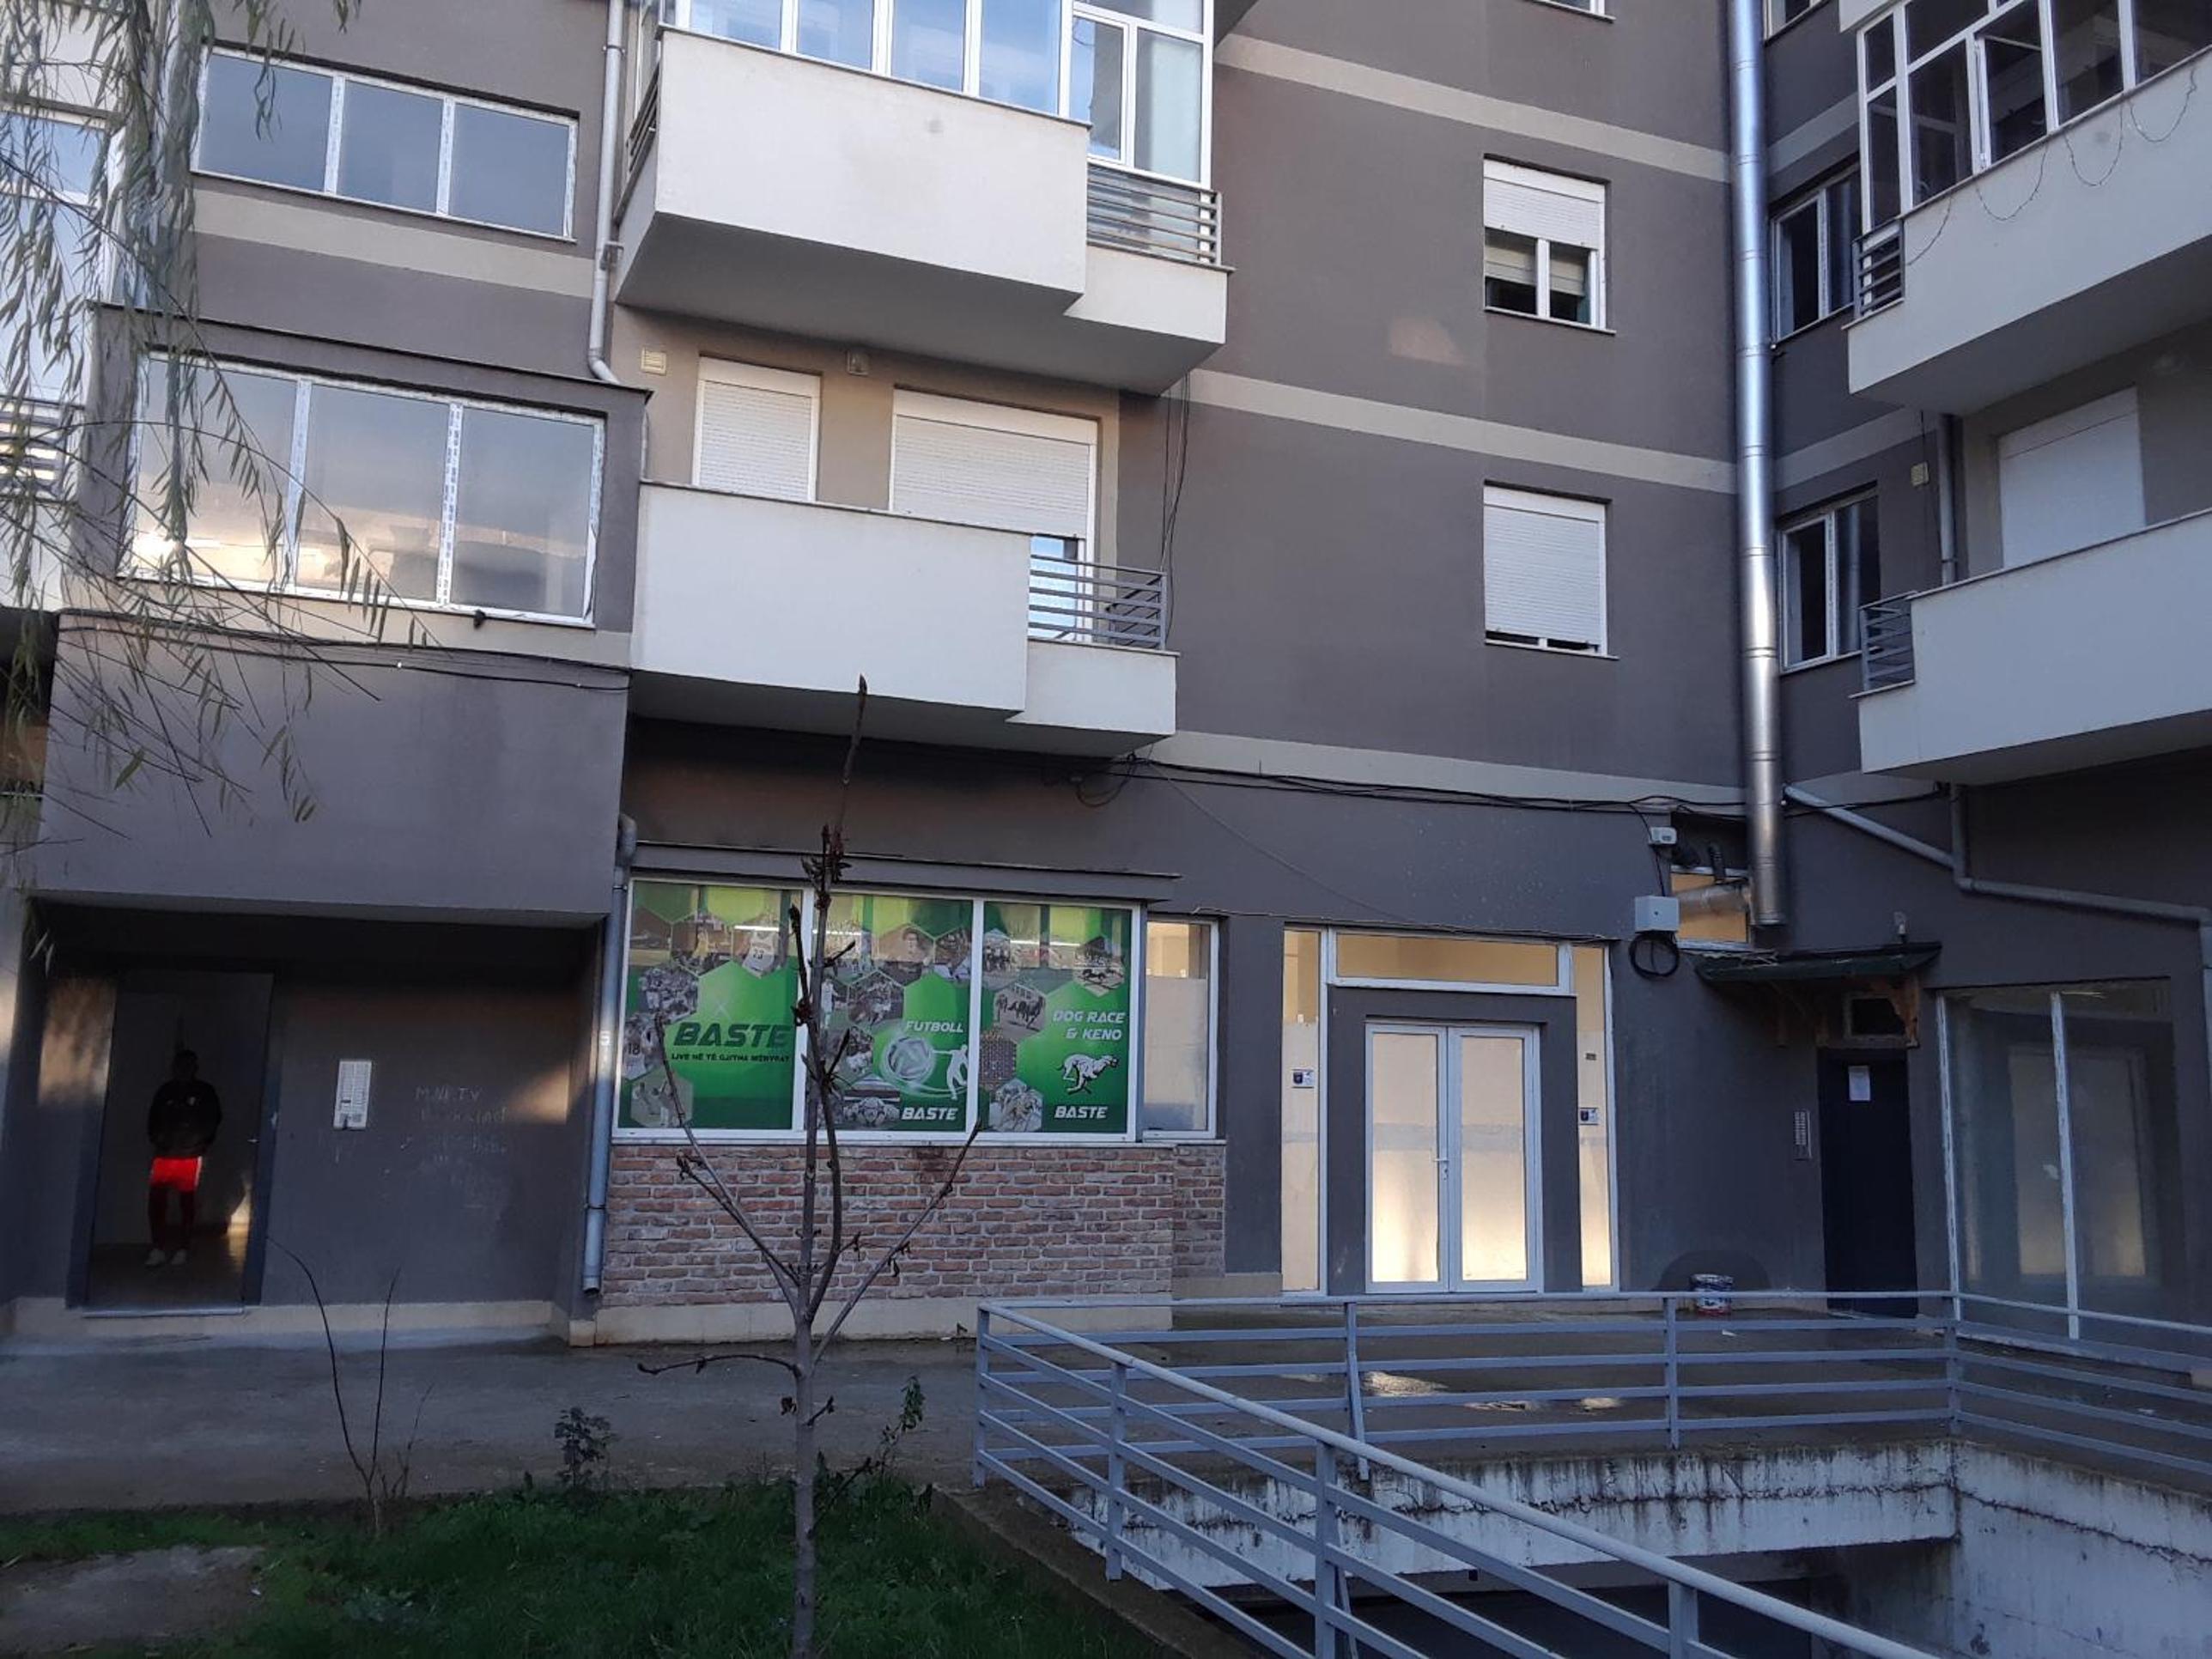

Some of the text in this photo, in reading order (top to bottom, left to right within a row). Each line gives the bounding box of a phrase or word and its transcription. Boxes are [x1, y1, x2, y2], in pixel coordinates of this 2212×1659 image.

[1053, 1010, 1125, 1024] DOG RACE
[906, 1020, 963, 1033] FUTBOLL
[673, 1022, 792, 1048] BASTE
[1066, 1028, 1122, 1040] & KENO
[901, 1106, 958, 1121] BASTE
[1054, 1105, 1108, 1119] BASTE
